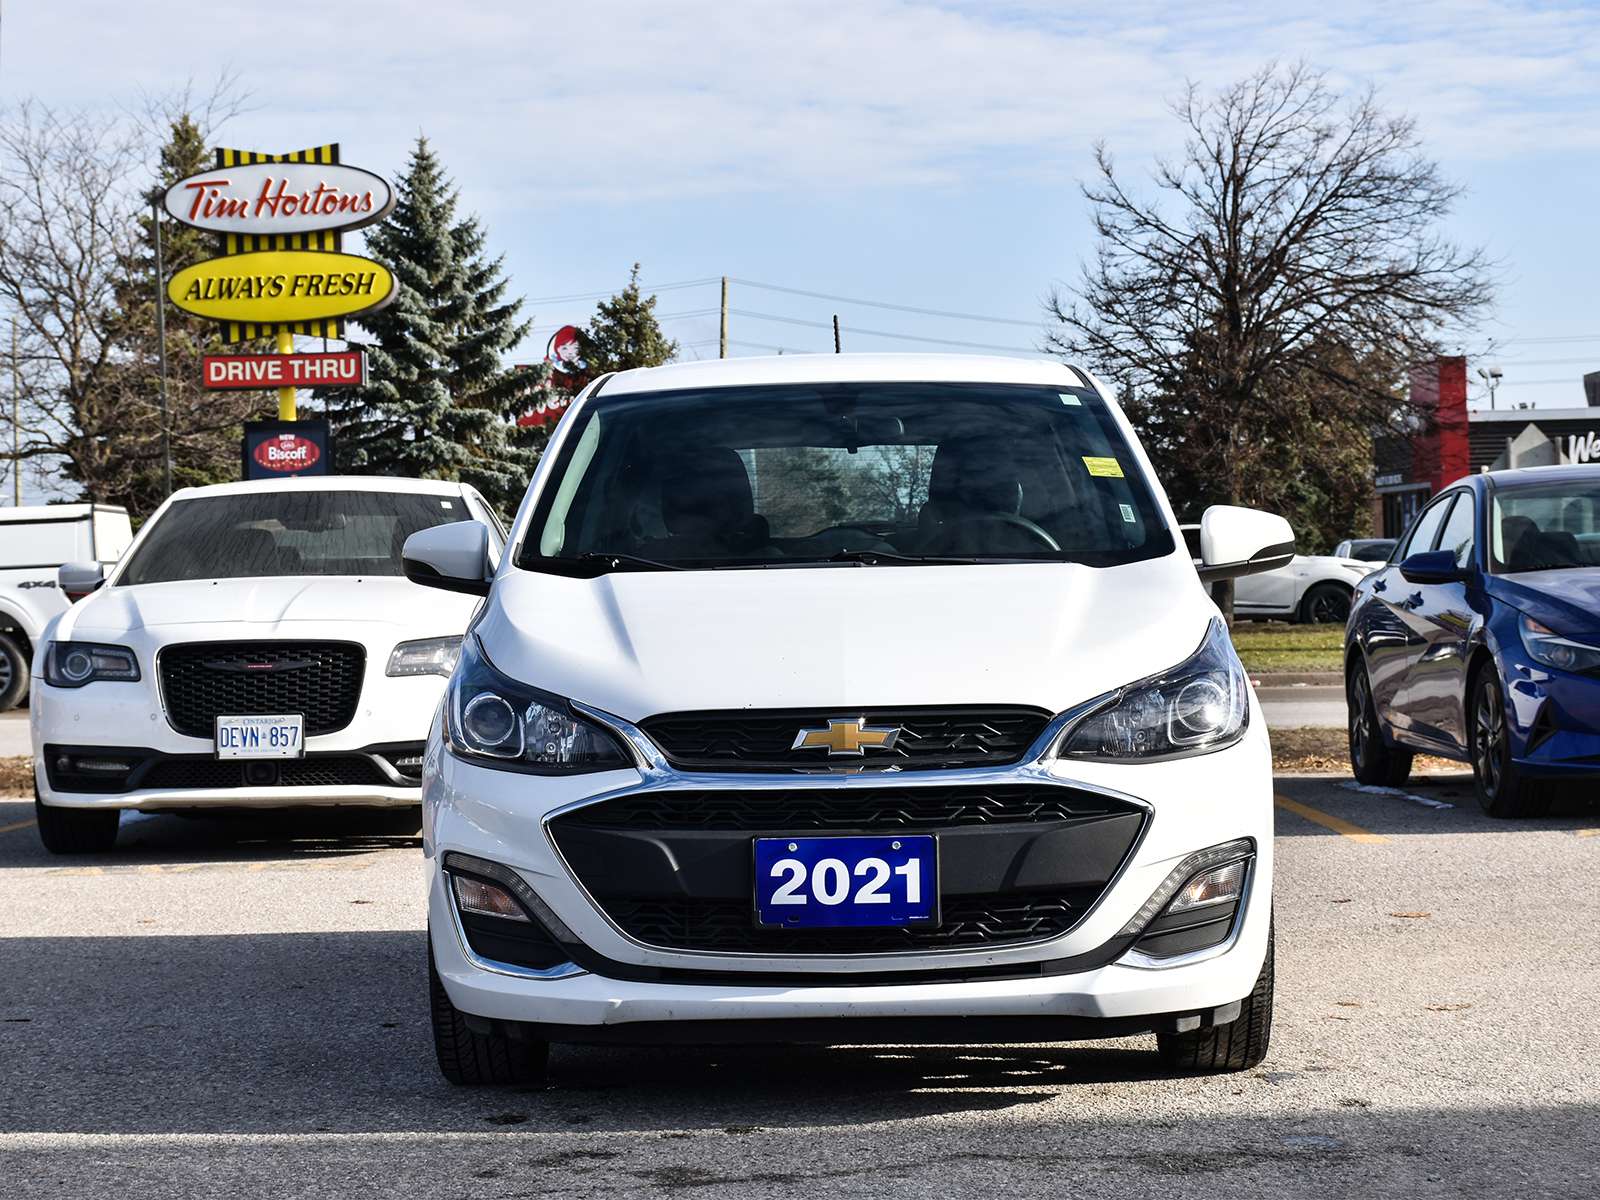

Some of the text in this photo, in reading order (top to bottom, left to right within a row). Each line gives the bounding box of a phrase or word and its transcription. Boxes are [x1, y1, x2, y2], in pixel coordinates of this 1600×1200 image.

[184, 175, 375, 221] Tim Hortons
[184, 272, 377, 300] ALWAYS FRESH
[209, 358, 356, 381] DRIVE THRU
[268, 446, 307, 461] Biscoff
[221, 726, 299, 748] DEVN 857
[770, 857, 921, 906] 2021
